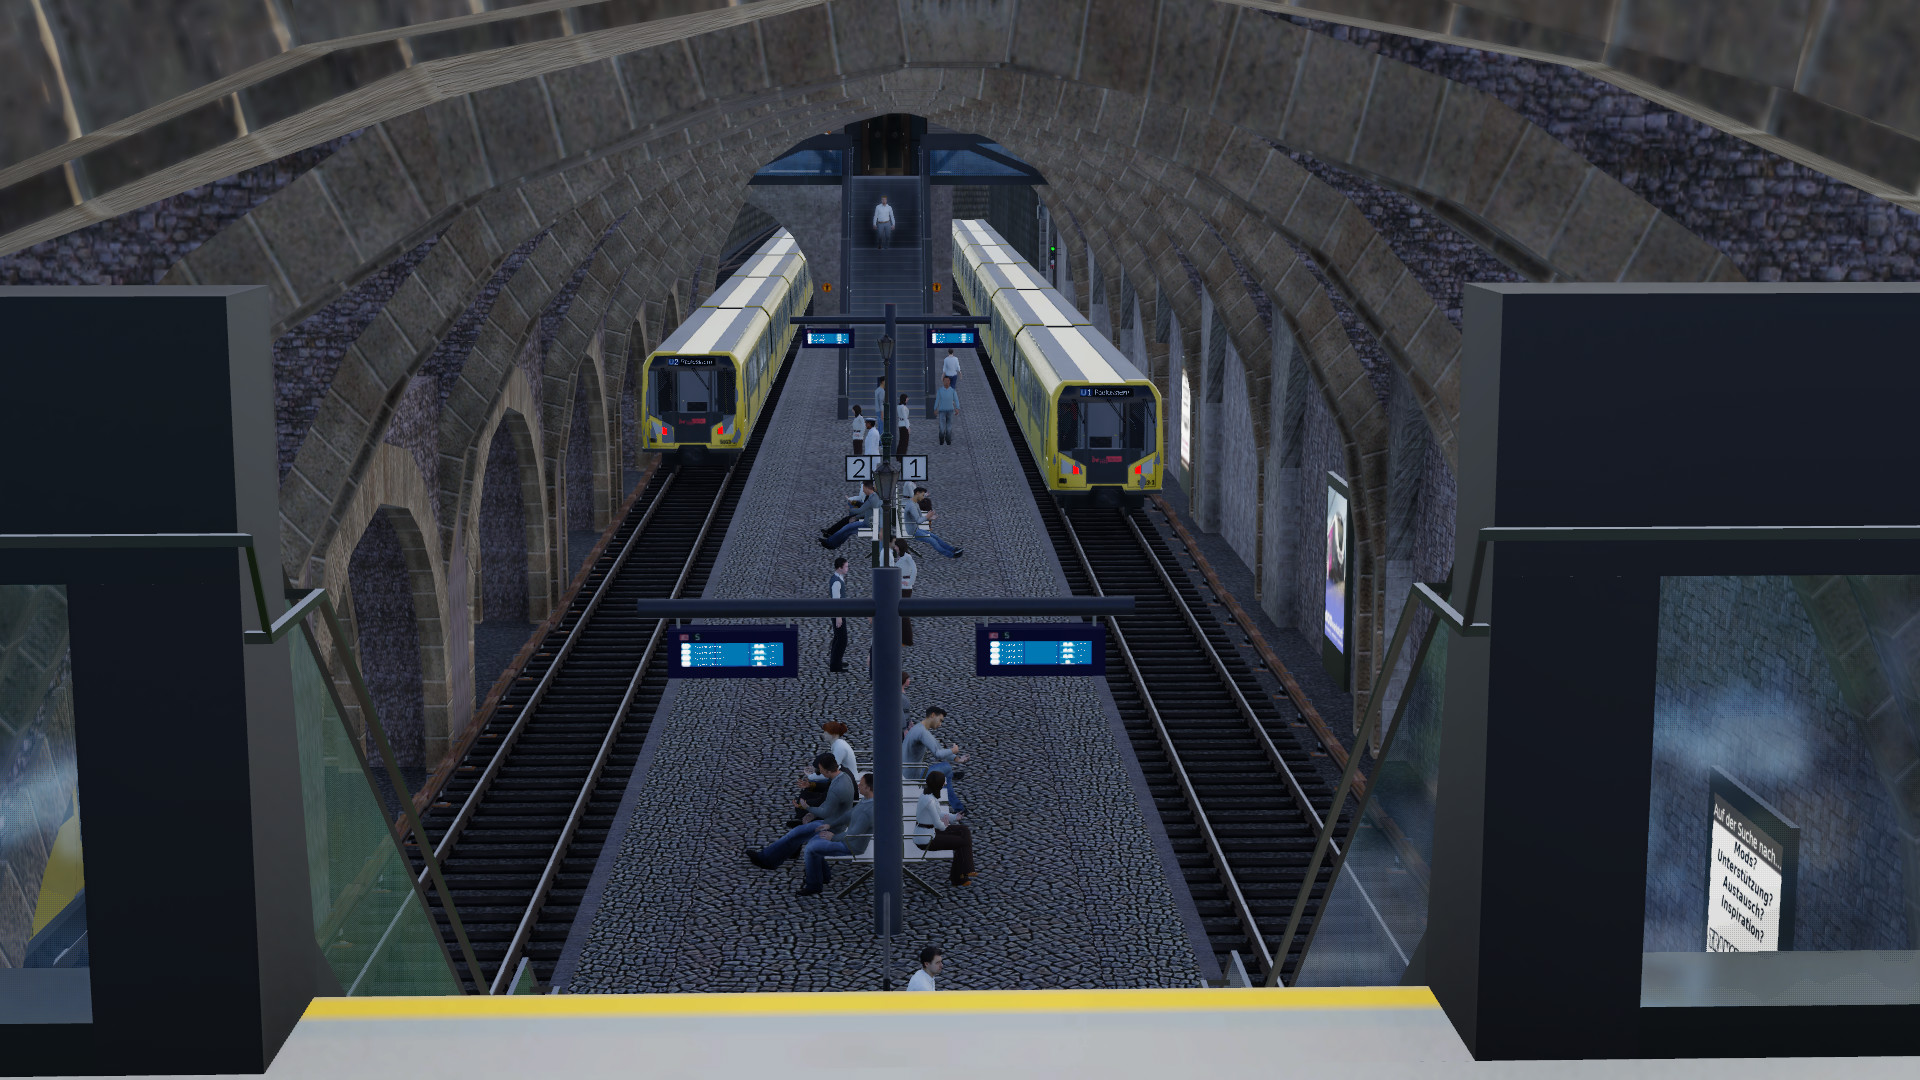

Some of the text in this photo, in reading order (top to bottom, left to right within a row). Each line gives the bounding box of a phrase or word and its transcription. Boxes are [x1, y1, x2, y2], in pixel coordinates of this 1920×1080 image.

[1080, 389, 1092, 397] U1
[852, 458, 866, 478] 2
[909, 458, 921, 478] 1
[1713, 803, 1726, 822] Auf
[1725, 813, 1738, 831] der
[1737, 822, 1758, 849] Suche
[1733, 841, 1758, 870] Mods?
[1717, 848, 1774, 907] Unterstützung?
[1722, 876, 1765, 921] Austausch?
[1721, 894, 1765, 943] Inspiration?
